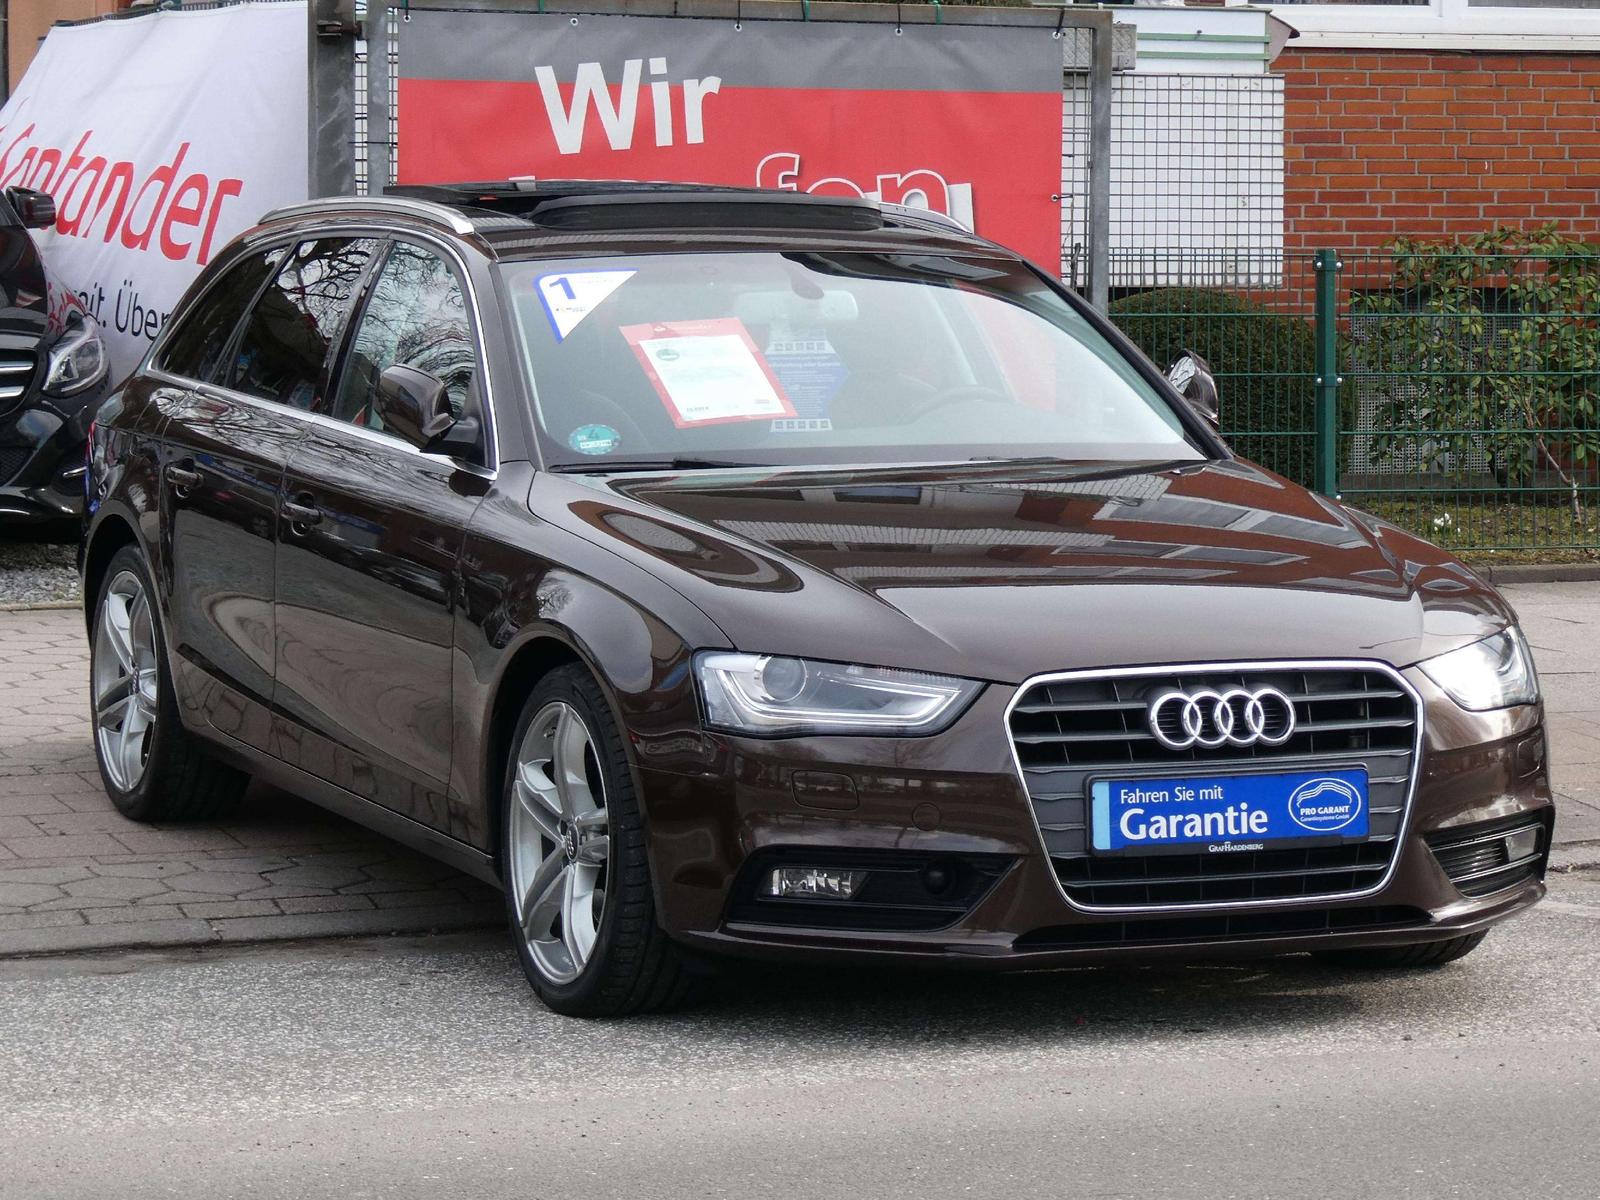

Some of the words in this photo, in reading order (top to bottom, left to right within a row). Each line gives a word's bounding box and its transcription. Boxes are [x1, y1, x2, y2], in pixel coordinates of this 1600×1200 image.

[535, 57, 722, 155] Wir
[548, 277, 577, 300] 1
[1120, 788, 1169, 804] Fahren
[1174, 786, 1194, 802] Sie
[1200, 785, 1223, 800] mit
[1120, 802, 1268, 840] Garantie
[1300, 807, 1316, 816] PRO
[1318, 805, 1350, 815] GARANT
